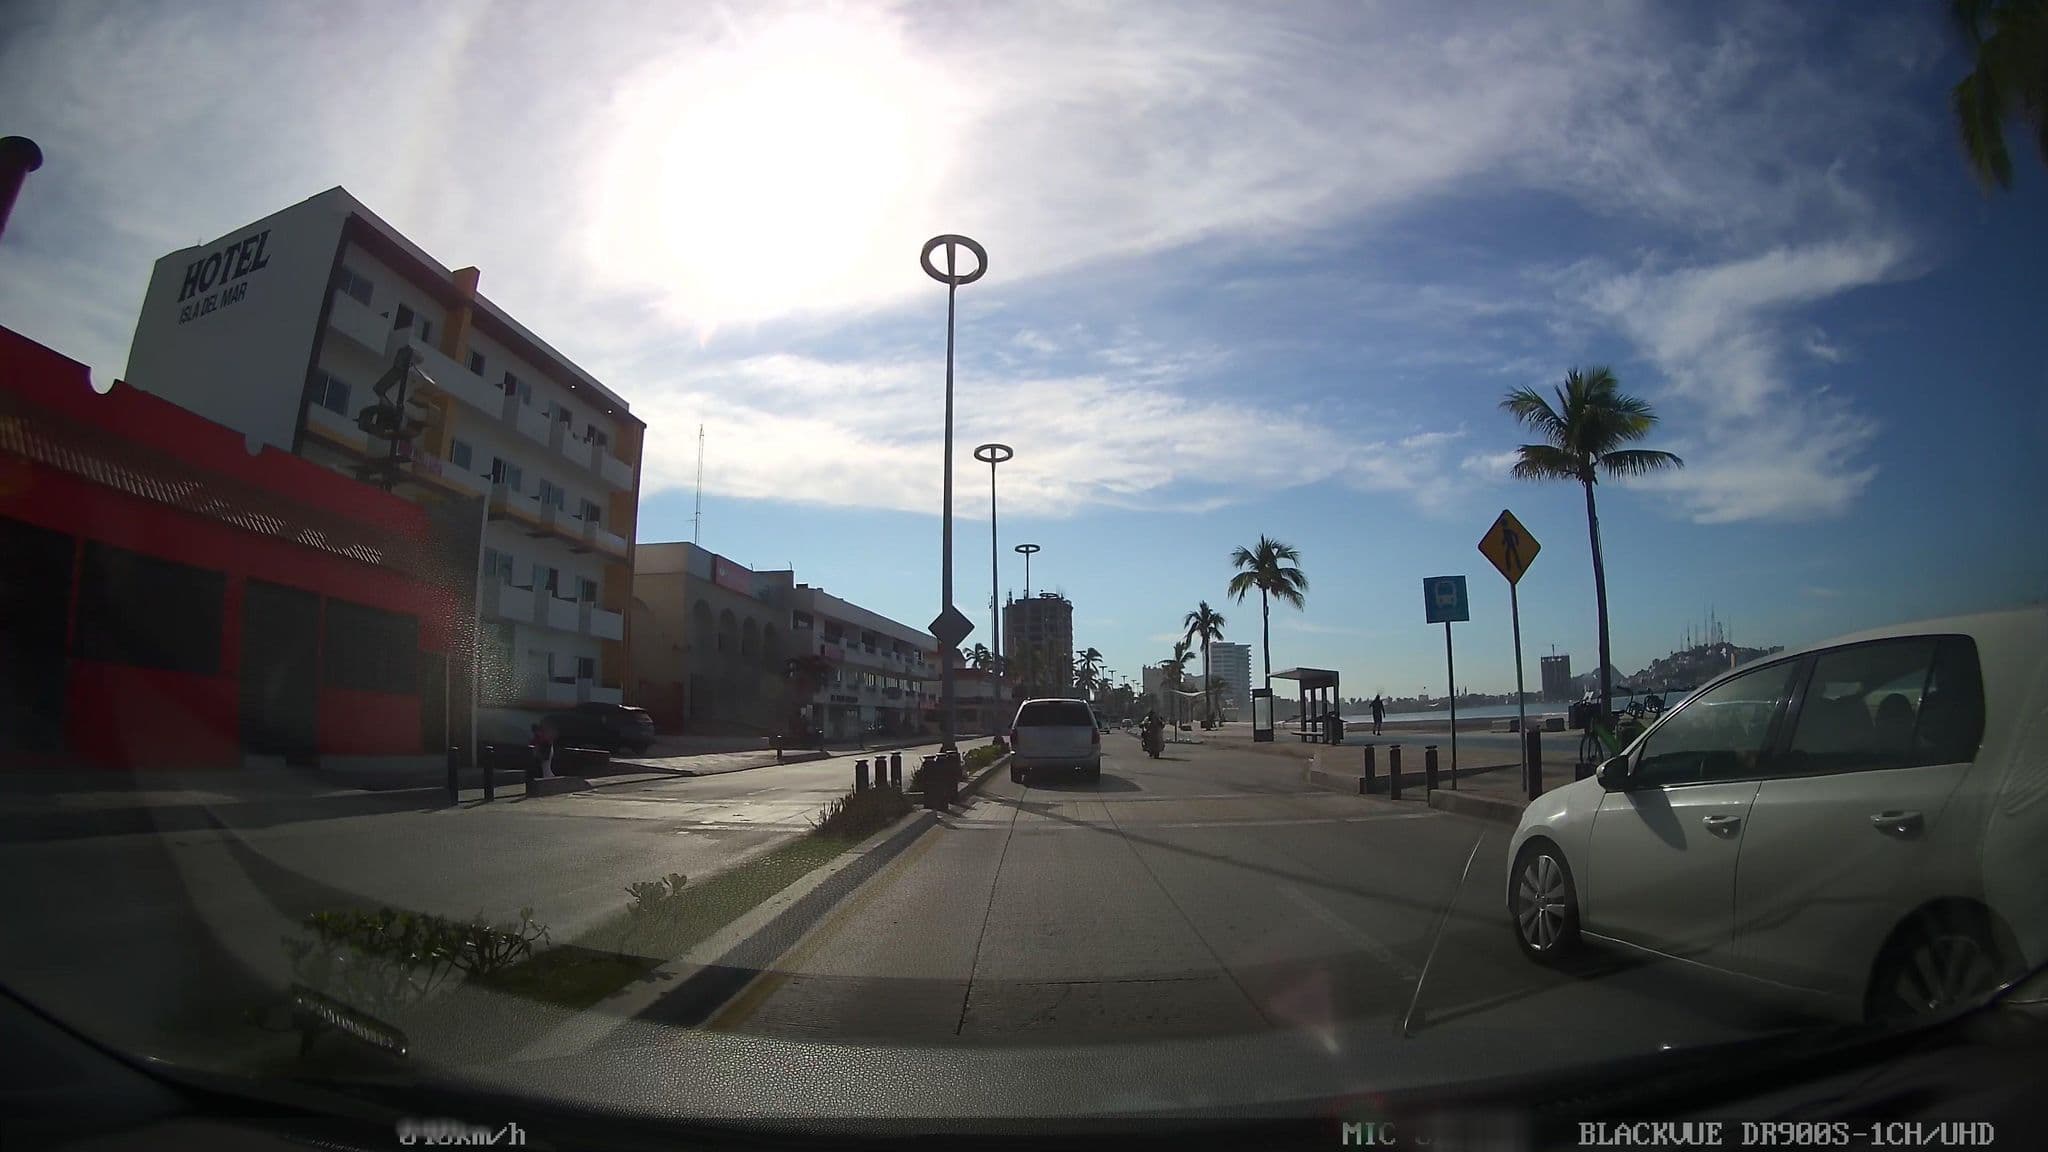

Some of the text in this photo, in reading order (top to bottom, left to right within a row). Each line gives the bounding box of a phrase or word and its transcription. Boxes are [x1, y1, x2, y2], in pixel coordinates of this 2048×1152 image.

[177, 229, 271, 302] HOTEL
[178, 282, 248, 325] ISLA DEL MAR
